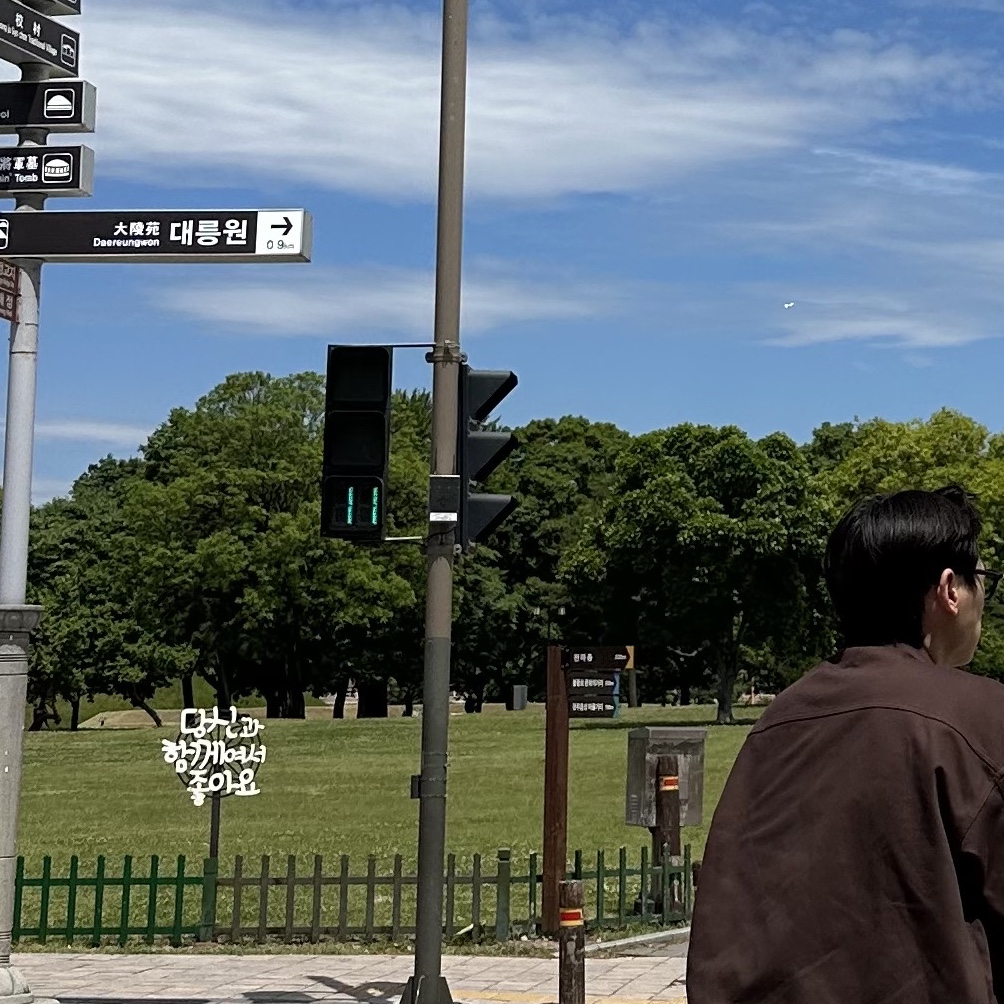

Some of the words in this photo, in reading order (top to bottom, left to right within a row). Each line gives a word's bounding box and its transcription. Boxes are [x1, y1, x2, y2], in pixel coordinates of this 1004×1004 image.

[14, 172, 39, 183] Tomb
[113, 221, 161, 236] 大陵苑
[169, 219, 248, 246] 대릉원
[92, 237, 160, 248] Daereungwon
[266, 239, 294, 250] 09km
[180, 705, 265, 738] 당신과
[161, 738, 267, 773] 함께여서
[186, 768, 261, 807] 좋아요
